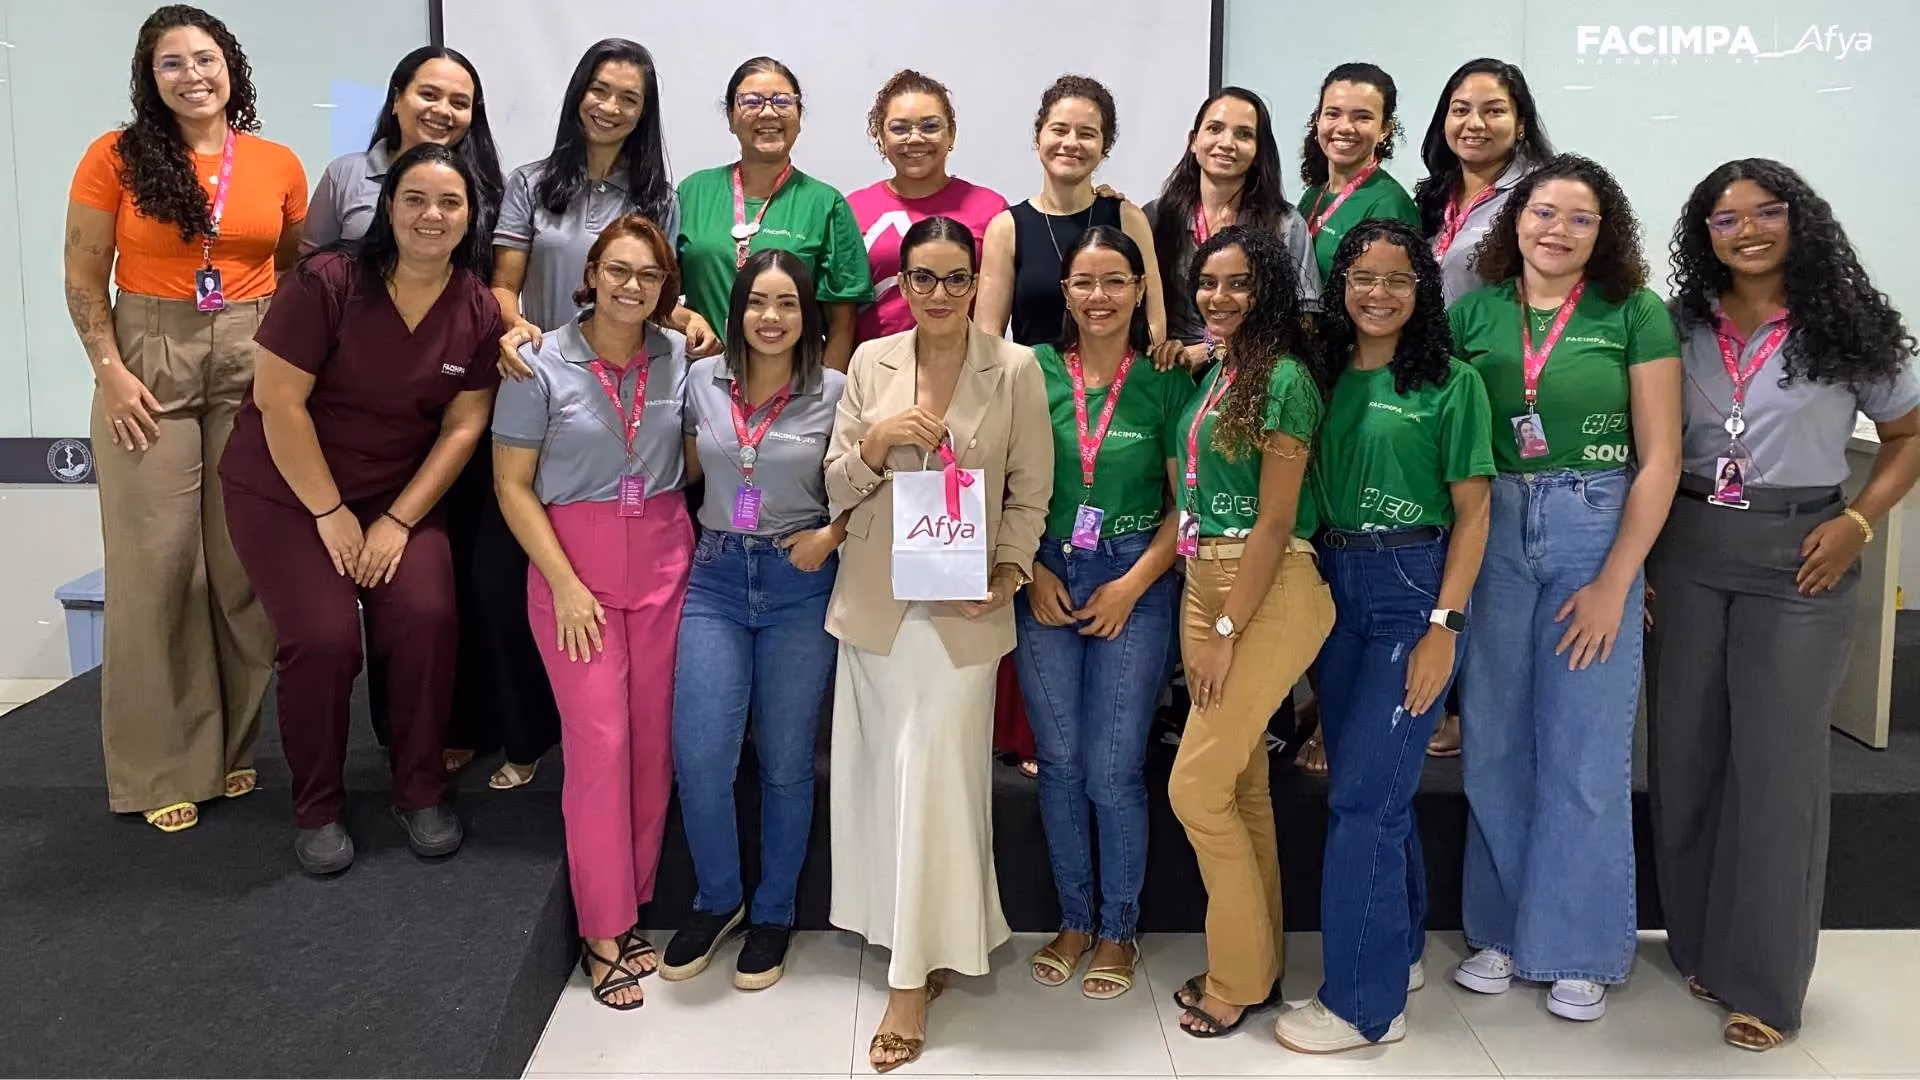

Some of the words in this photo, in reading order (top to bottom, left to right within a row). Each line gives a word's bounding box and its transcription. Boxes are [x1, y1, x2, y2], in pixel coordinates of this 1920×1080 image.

[1565, 337, 1606, 345] FACIMPA
[768, 431, 801, 441] FACIMPA
[1107, 430, 1143, 439] FACIMPA
[1582, 444, 1629, 462] SOU
[1360, 487, 1423, 524] #EU
[907, 514, 976, 546] Afya
